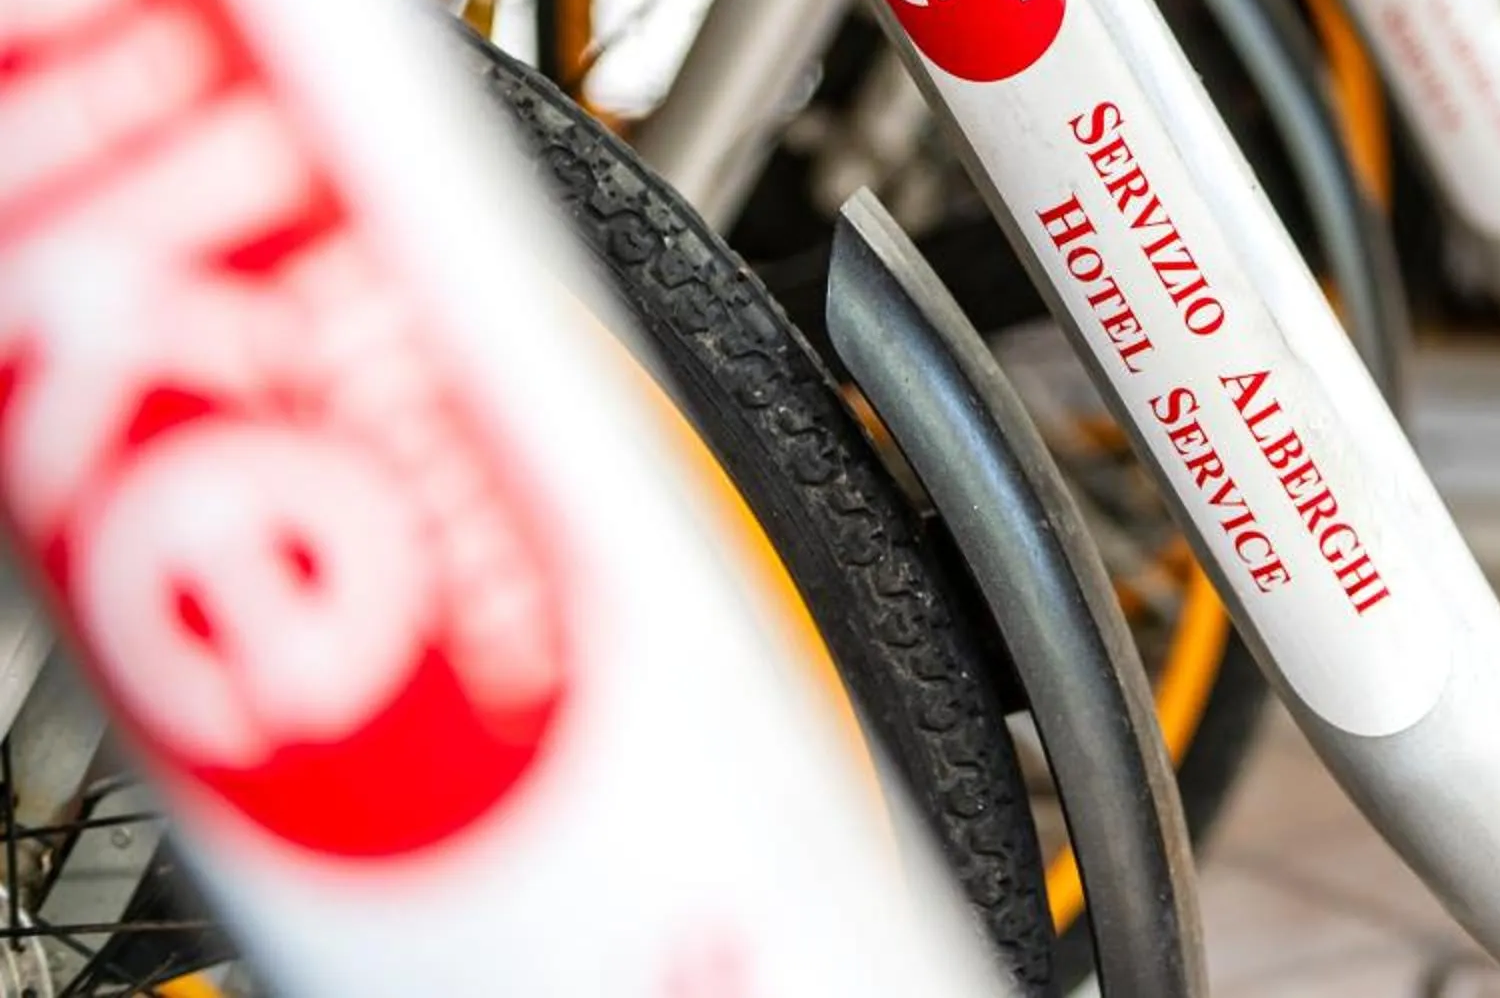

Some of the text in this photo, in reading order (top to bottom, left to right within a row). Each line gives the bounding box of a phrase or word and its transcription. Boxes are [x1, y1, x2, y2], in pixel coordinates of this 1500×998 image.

[1035, 193, 1295, 593] HOTEL SERVICE
[1068, 101, 1392, 617] SERVIZIO ALBERGHI
